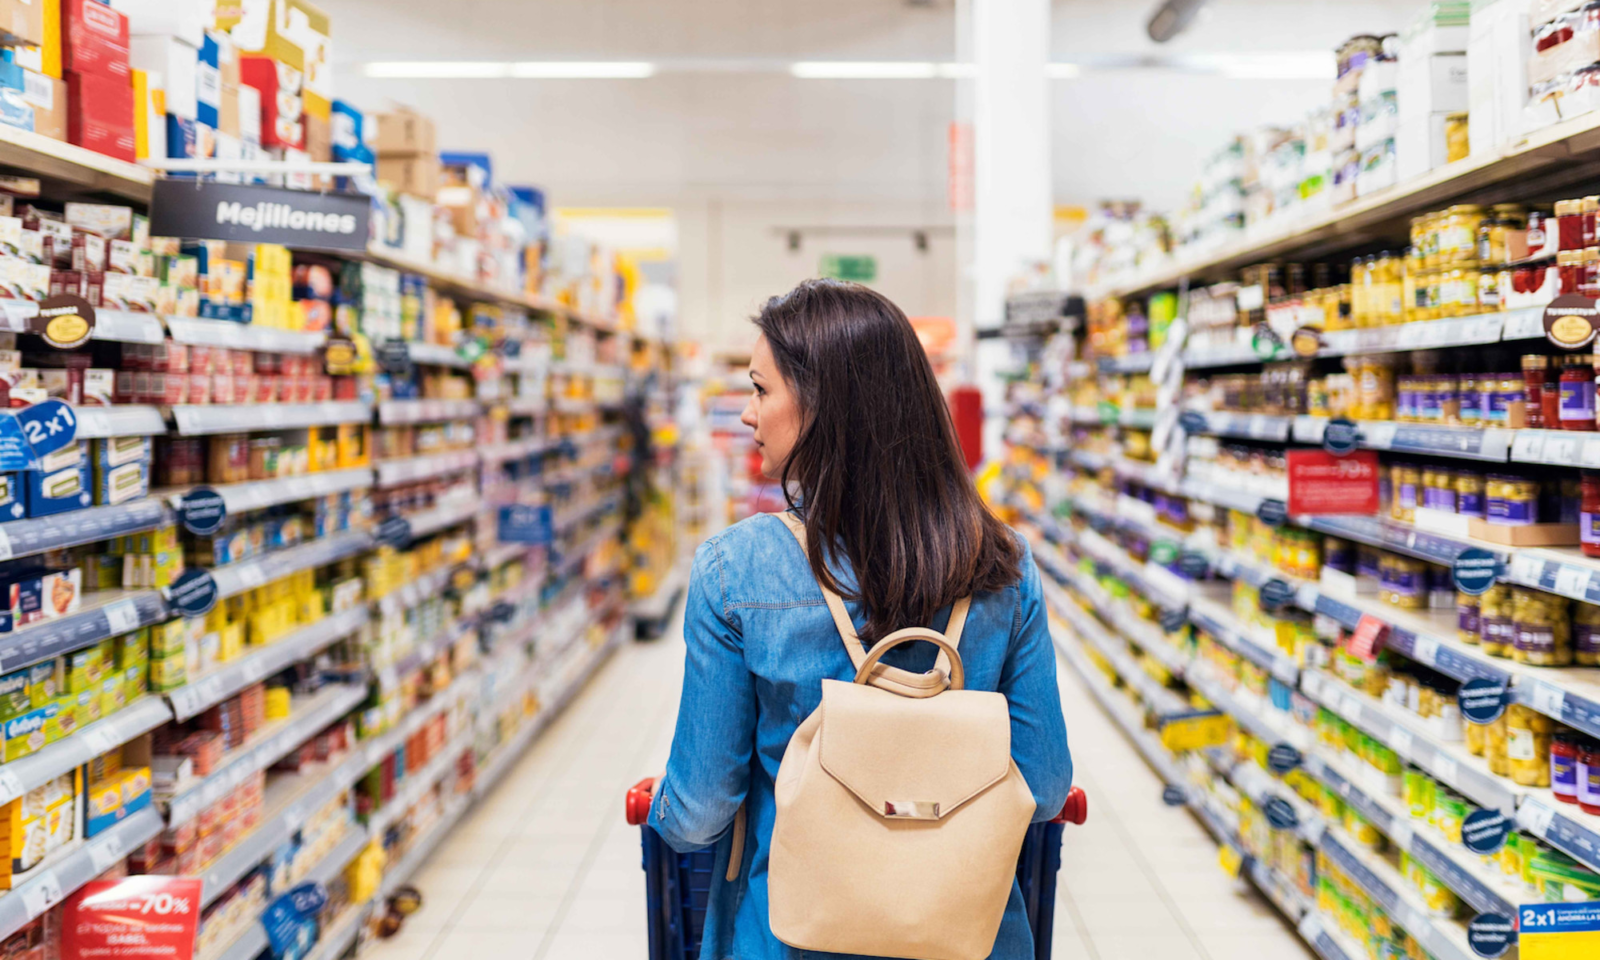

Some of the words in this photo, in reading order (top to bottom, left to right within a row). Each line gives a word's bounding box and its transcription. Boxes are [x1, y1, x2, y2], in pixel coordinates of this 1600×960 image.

[216, 201, 356, 234] Mejillones
[24, 405, 74, 445] 2x1
[128, 893, 190, 915] -70%
[1523, 909, 1555, 926] 2x1
